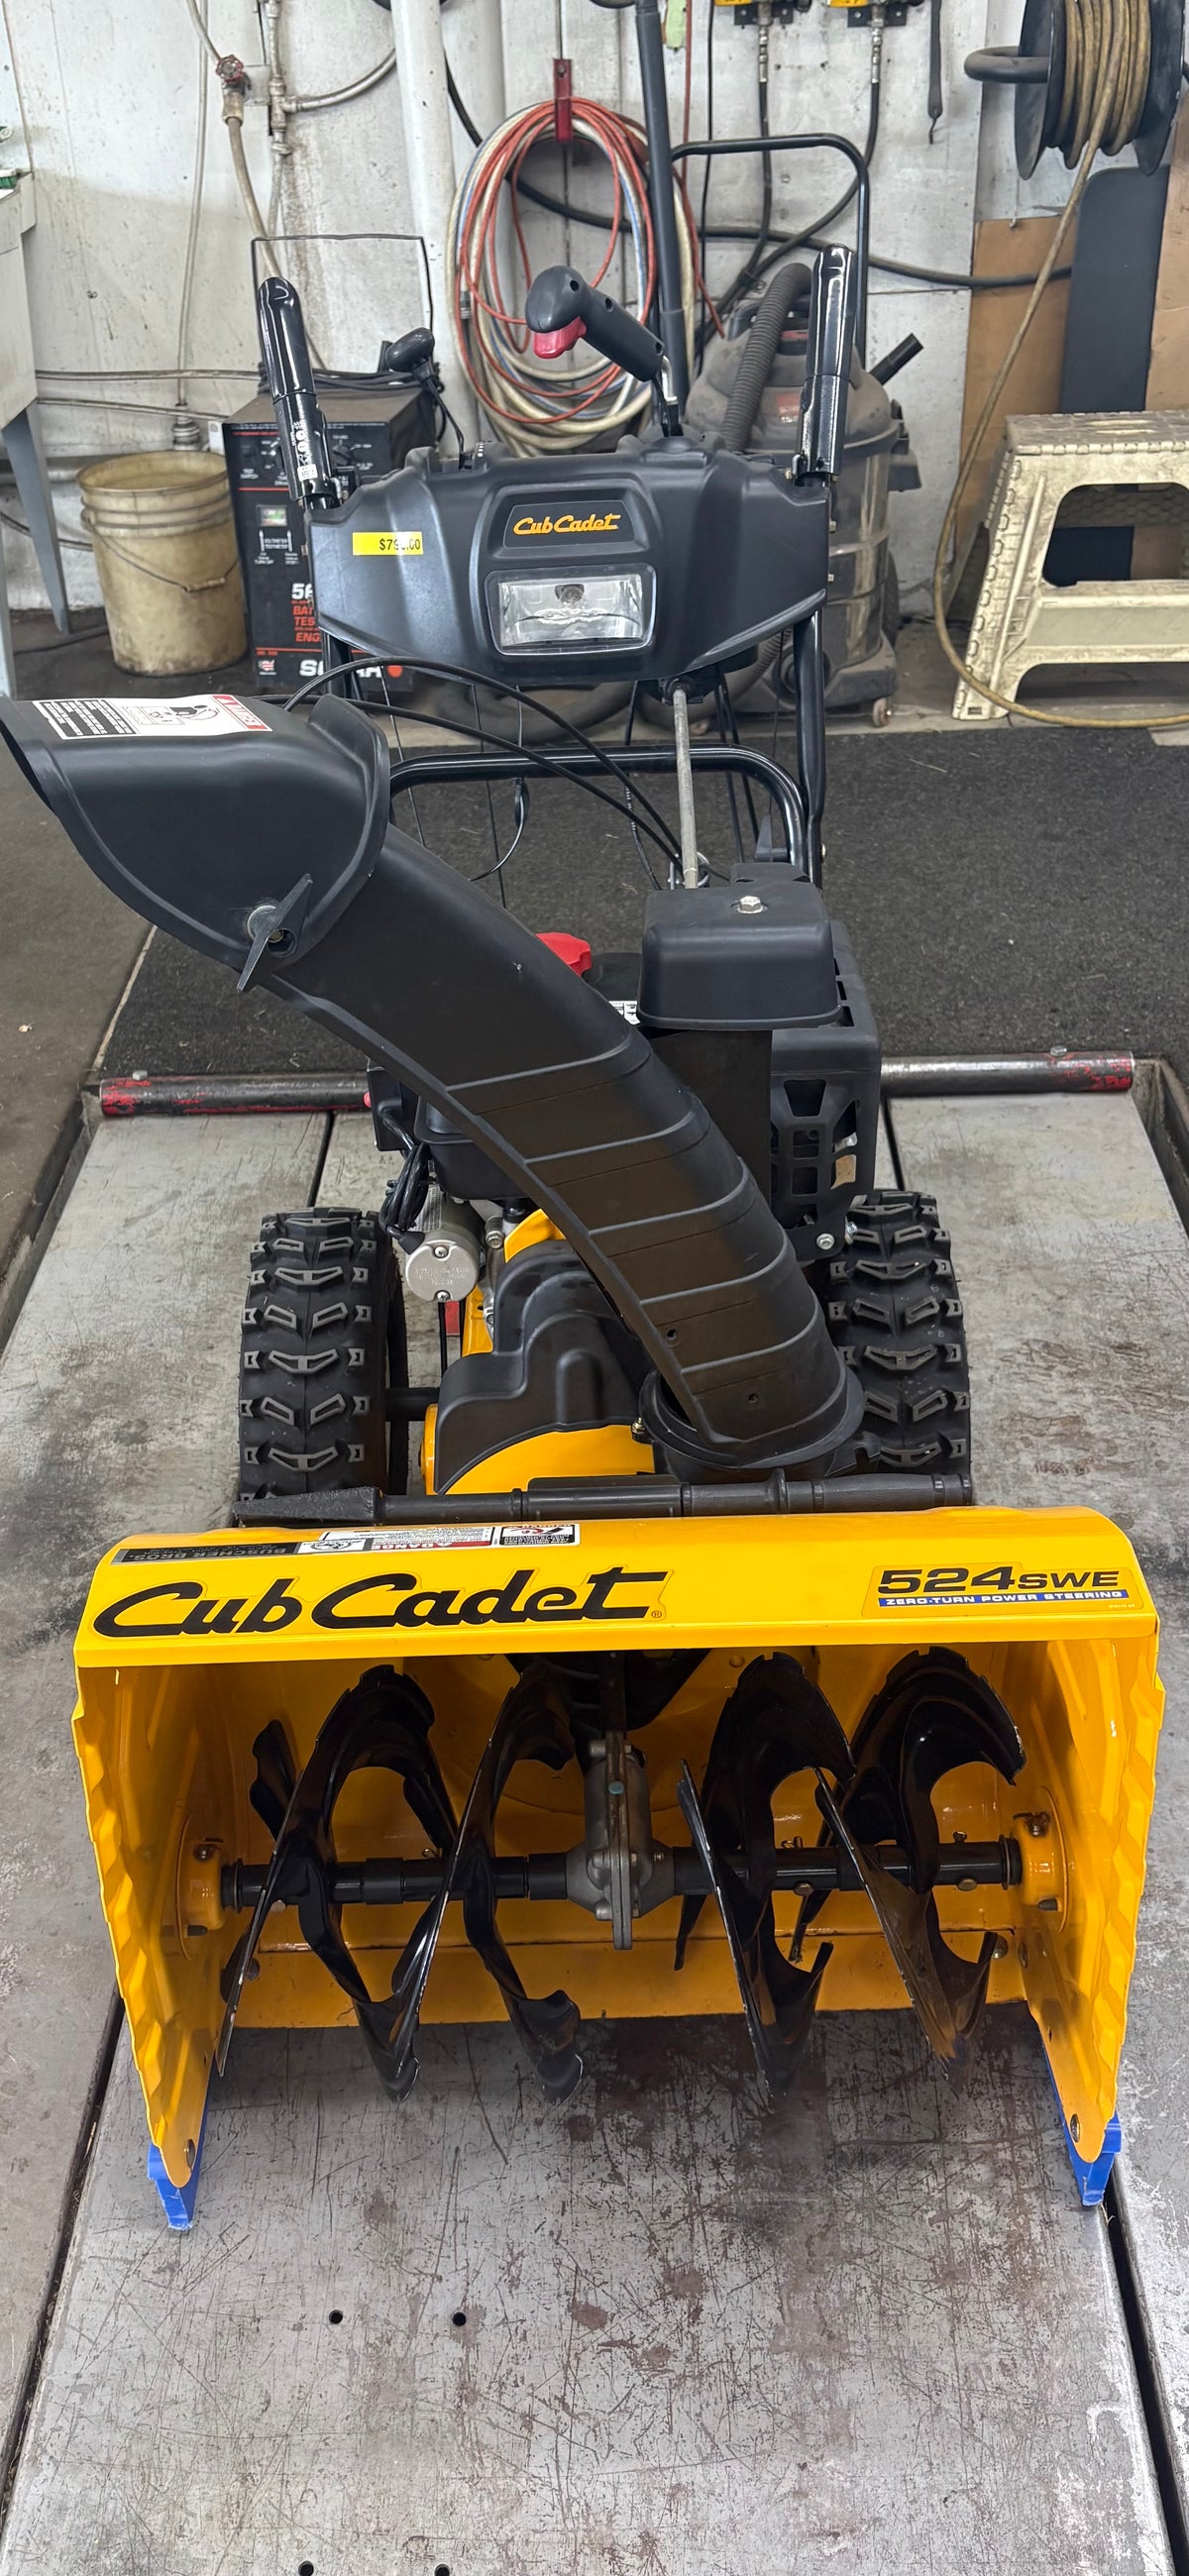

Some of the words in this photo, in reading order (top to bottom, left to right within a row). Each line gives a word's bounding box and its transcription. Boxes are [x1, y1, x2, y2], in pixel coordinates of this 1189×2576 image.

[513, 516, 553, 535] Cub
[554, 513, 621, 533] Cadet
[93, 1578, 303, 1638] Cub
[311, 1566, 668, 1630] Cadet
[886, 1595, 975, 1606] ZERO-TURN
[981, 1593, 1038, 1603] POWER
[1043, 1590, 1123, 1601] STEERING
